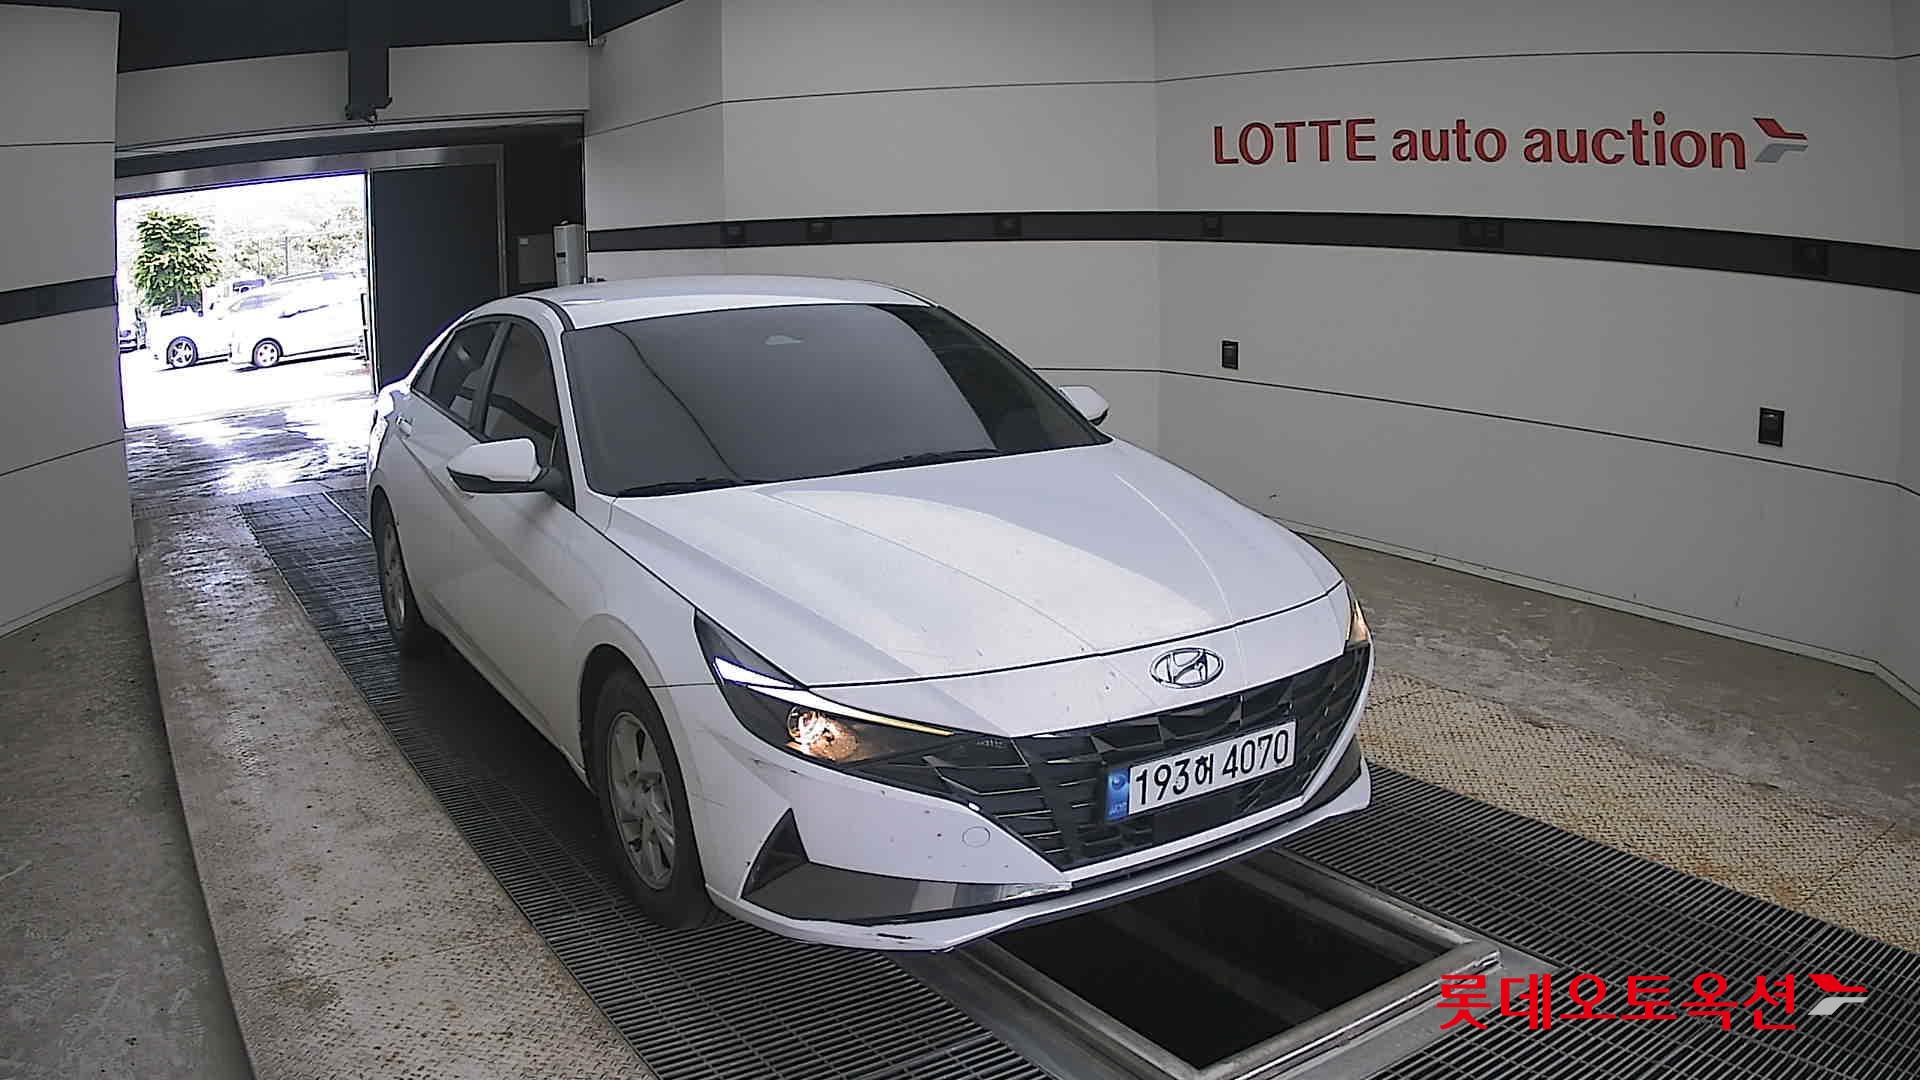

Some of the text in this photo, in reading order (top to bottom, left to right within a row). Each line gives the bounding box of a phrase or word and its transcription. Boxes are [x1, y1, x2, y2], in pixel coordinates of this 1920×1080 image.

[1213, 111, 1747, 170] LOTTE auto auction
[1135, 729, 1289, 805] 193허 4070
